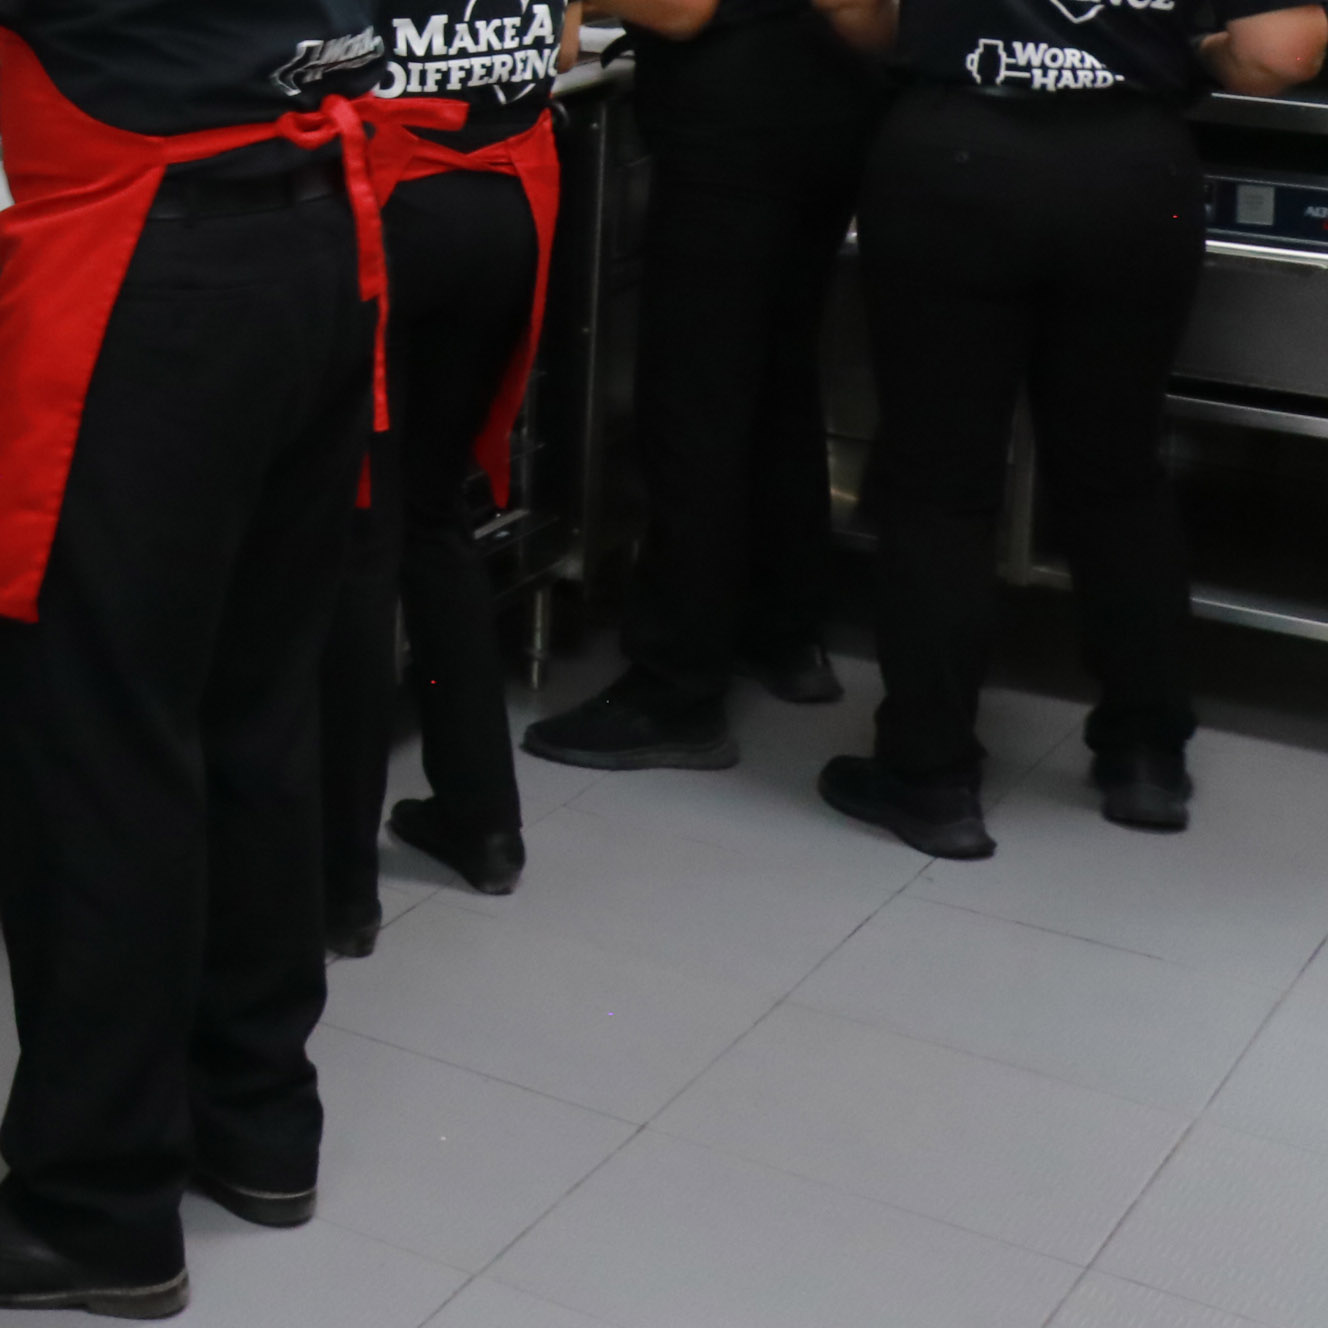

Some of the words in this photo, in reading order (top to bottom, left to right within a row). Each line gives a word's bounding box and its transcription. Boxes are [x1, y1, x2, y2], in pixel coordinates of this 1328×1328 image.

[391, 13, 523, 58] MAKE
[522, 3, 554, 45] A
[1031, 68, 1113, 92] HARD
